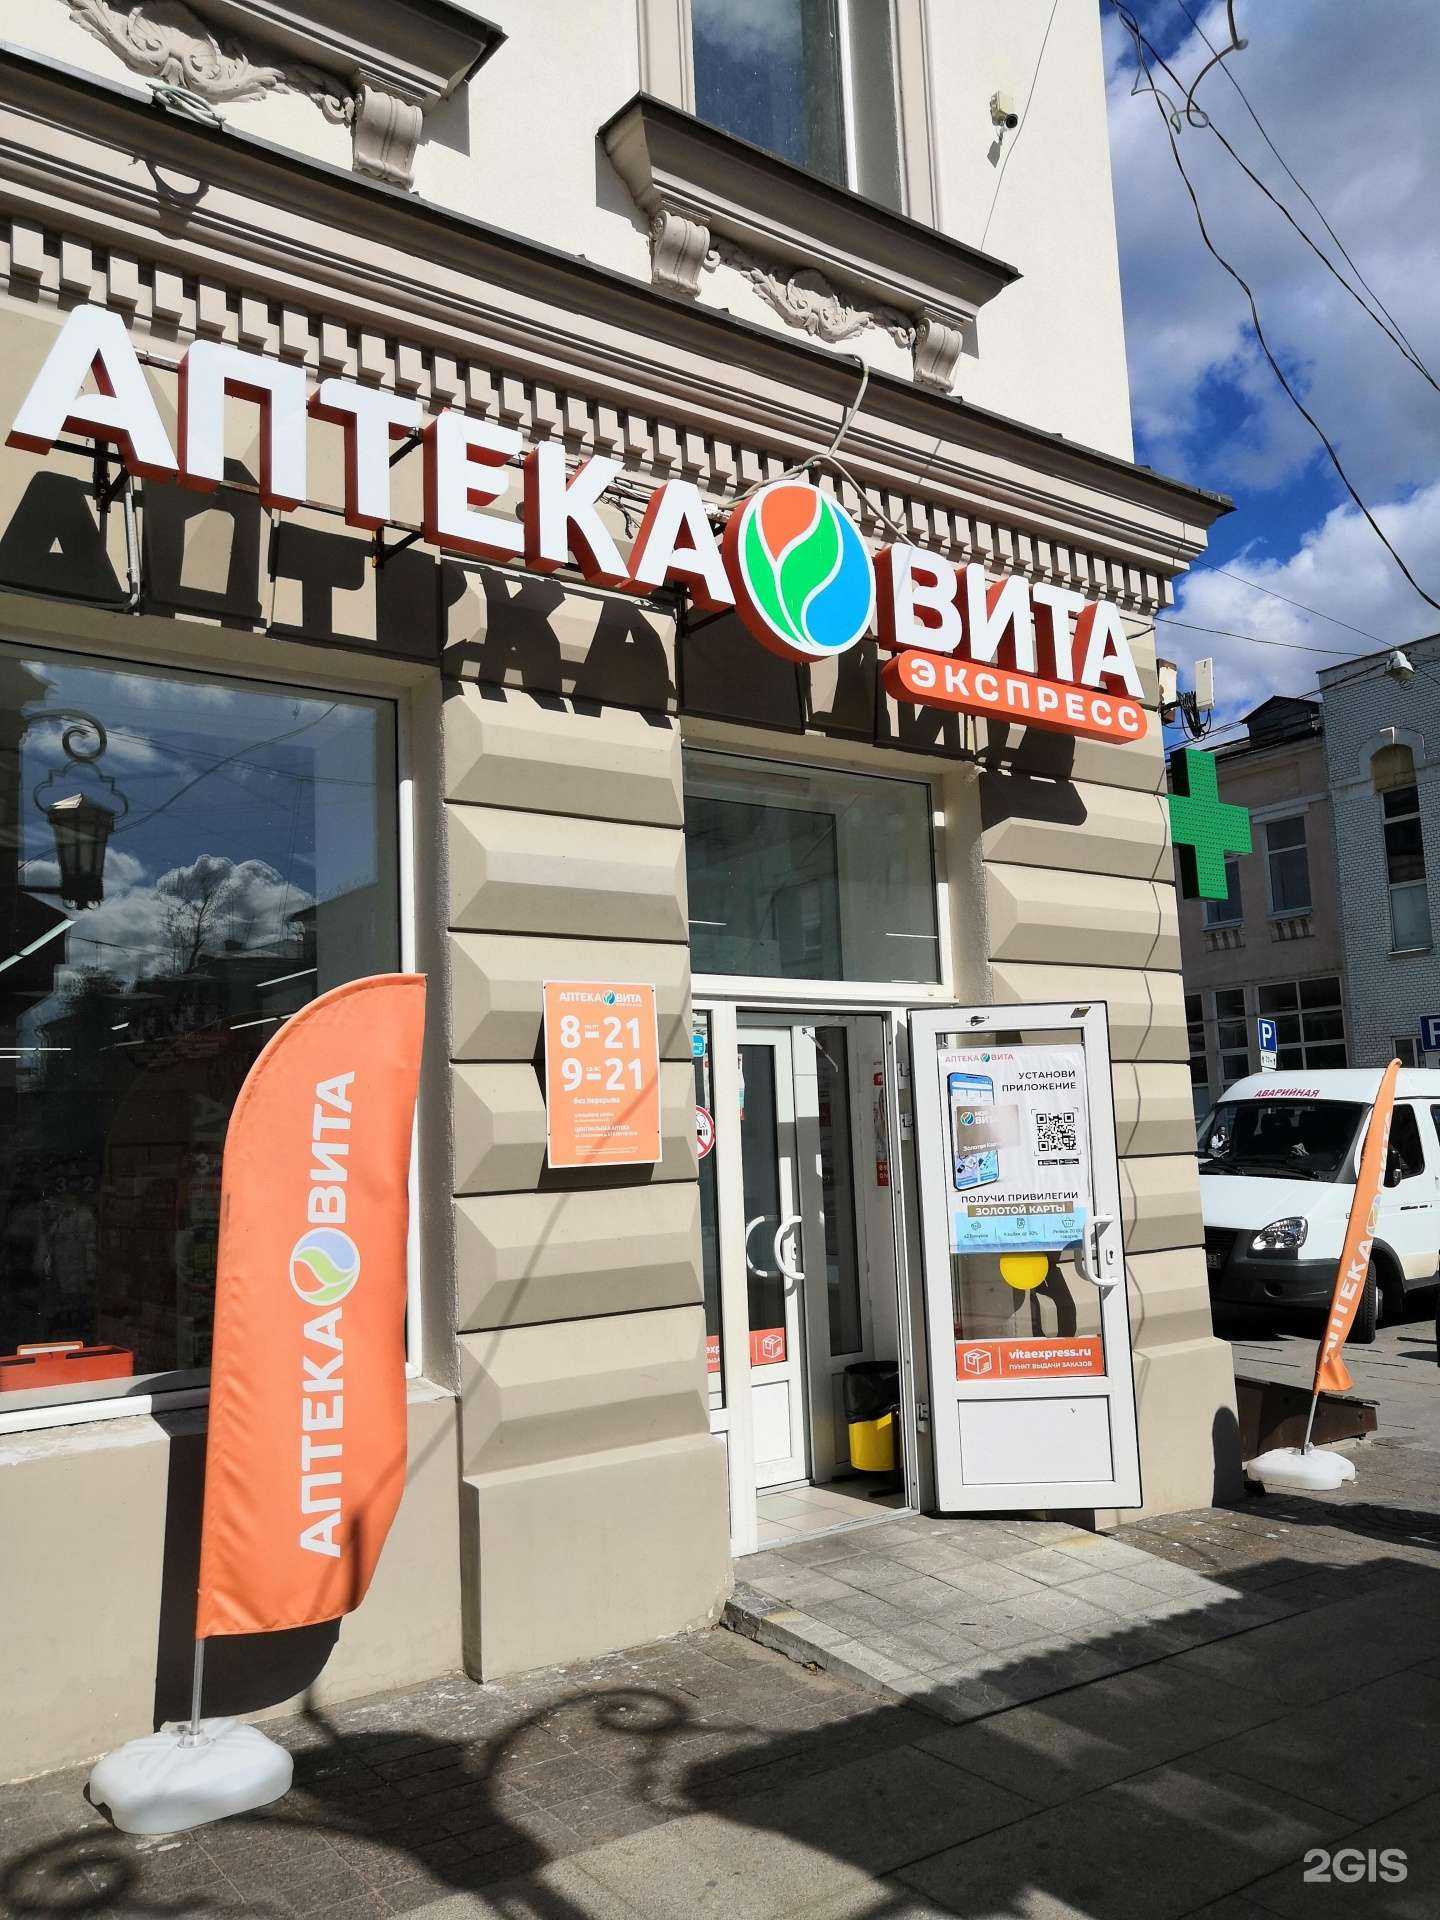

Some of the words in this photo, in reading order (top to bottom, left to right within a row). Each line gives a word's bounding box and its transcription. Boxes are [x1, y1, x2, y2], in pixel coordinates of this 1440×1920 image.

[7, 304, 735, 610] АПТЕКА
[880, 542, 1144, 699] ВИТА
[910, 657, 1140, 733] ЭКСПРЕСС
[559, 991, 602, 1003] АПТЕКА
[945, 1055, 979, 1063] АПТЕКА
[991, 1053, 1014, 1061] ВИТА
[1018, 1070, 1076, 1080] УСТАНОВИ
[1002, 1081, 1077, 1092] ПРИЛОЖЕНИЕ
[1254, 1087, 1320, 1098] АВАРИЙНАЯ
[308, 1071, 355, 1224] ВИТА
[961, 1194, 1005, 1204] ПОЛУЧИ
[1008, 1191, 1079, 1202] ПРИВИЛЕГИИ
[975, 1205, 1026, 1216] ЗОЛОТОЙ
[1028, 1204, 1066, 1213] КАРТЫ
[1009, 1348, 1092, 1360] vitaexpress.ru
[1032, 1361, 1061, 1369] ВЫДАЧИ
[299, 1306, 344, 1558] АПТЕКА
